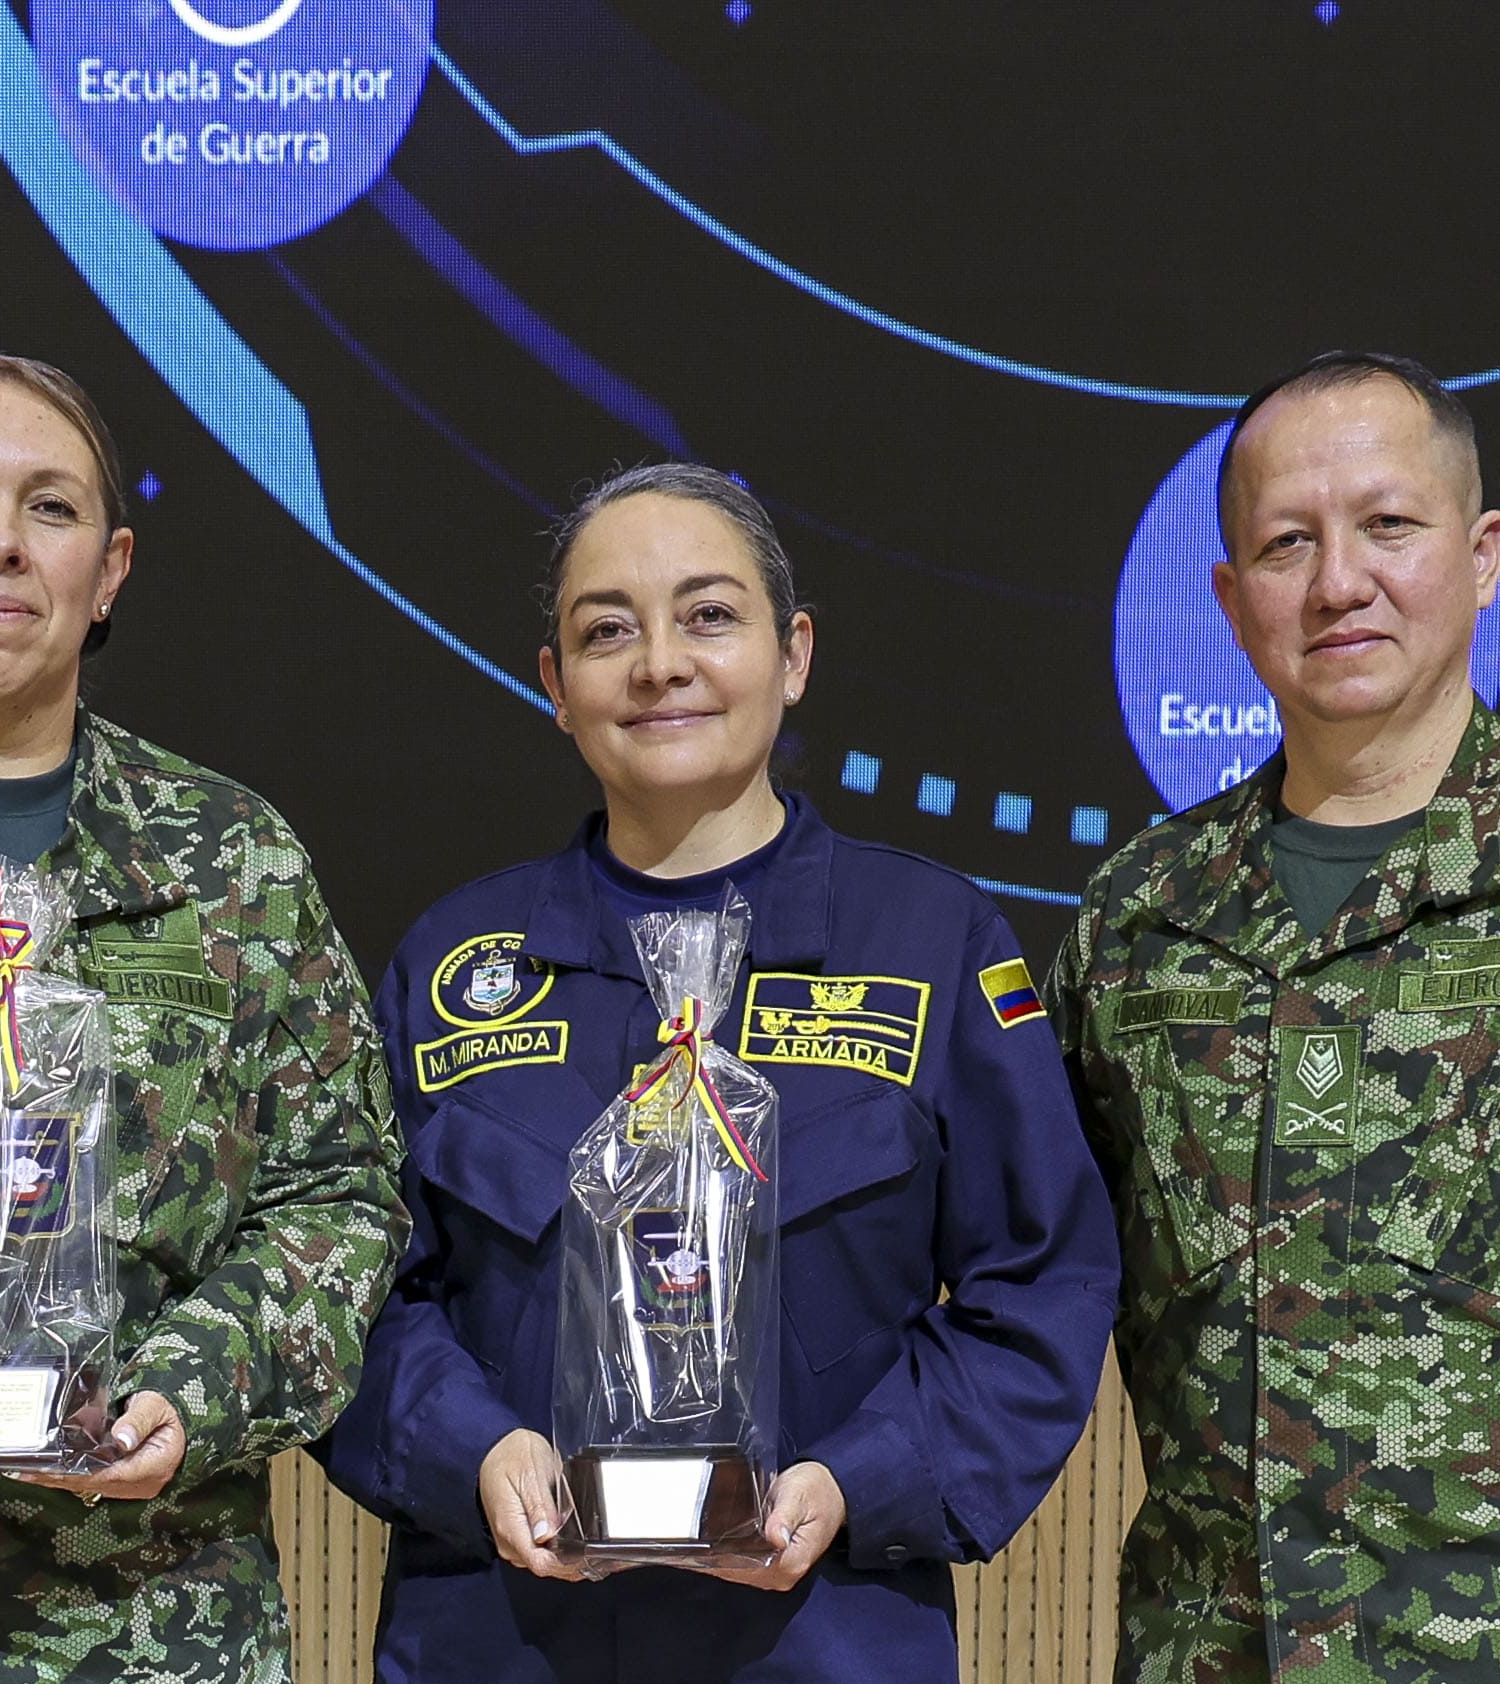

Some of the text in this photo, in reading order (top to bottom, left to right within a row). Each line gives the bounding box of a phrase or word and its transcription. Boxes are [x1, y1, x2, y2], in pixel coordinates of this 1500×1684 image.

[79, 58, 393, 108] Escuela Superior
[140, 121, 330, 165] de Guerra
[1160, 694, 1282, 736] Escuel
[1219, 754, 1256, 791] d
[441, 948, 476, 985] ARMADA
[480, 940, 497, 951] DE
[771, 1039, 888, 1071] ARMADA
